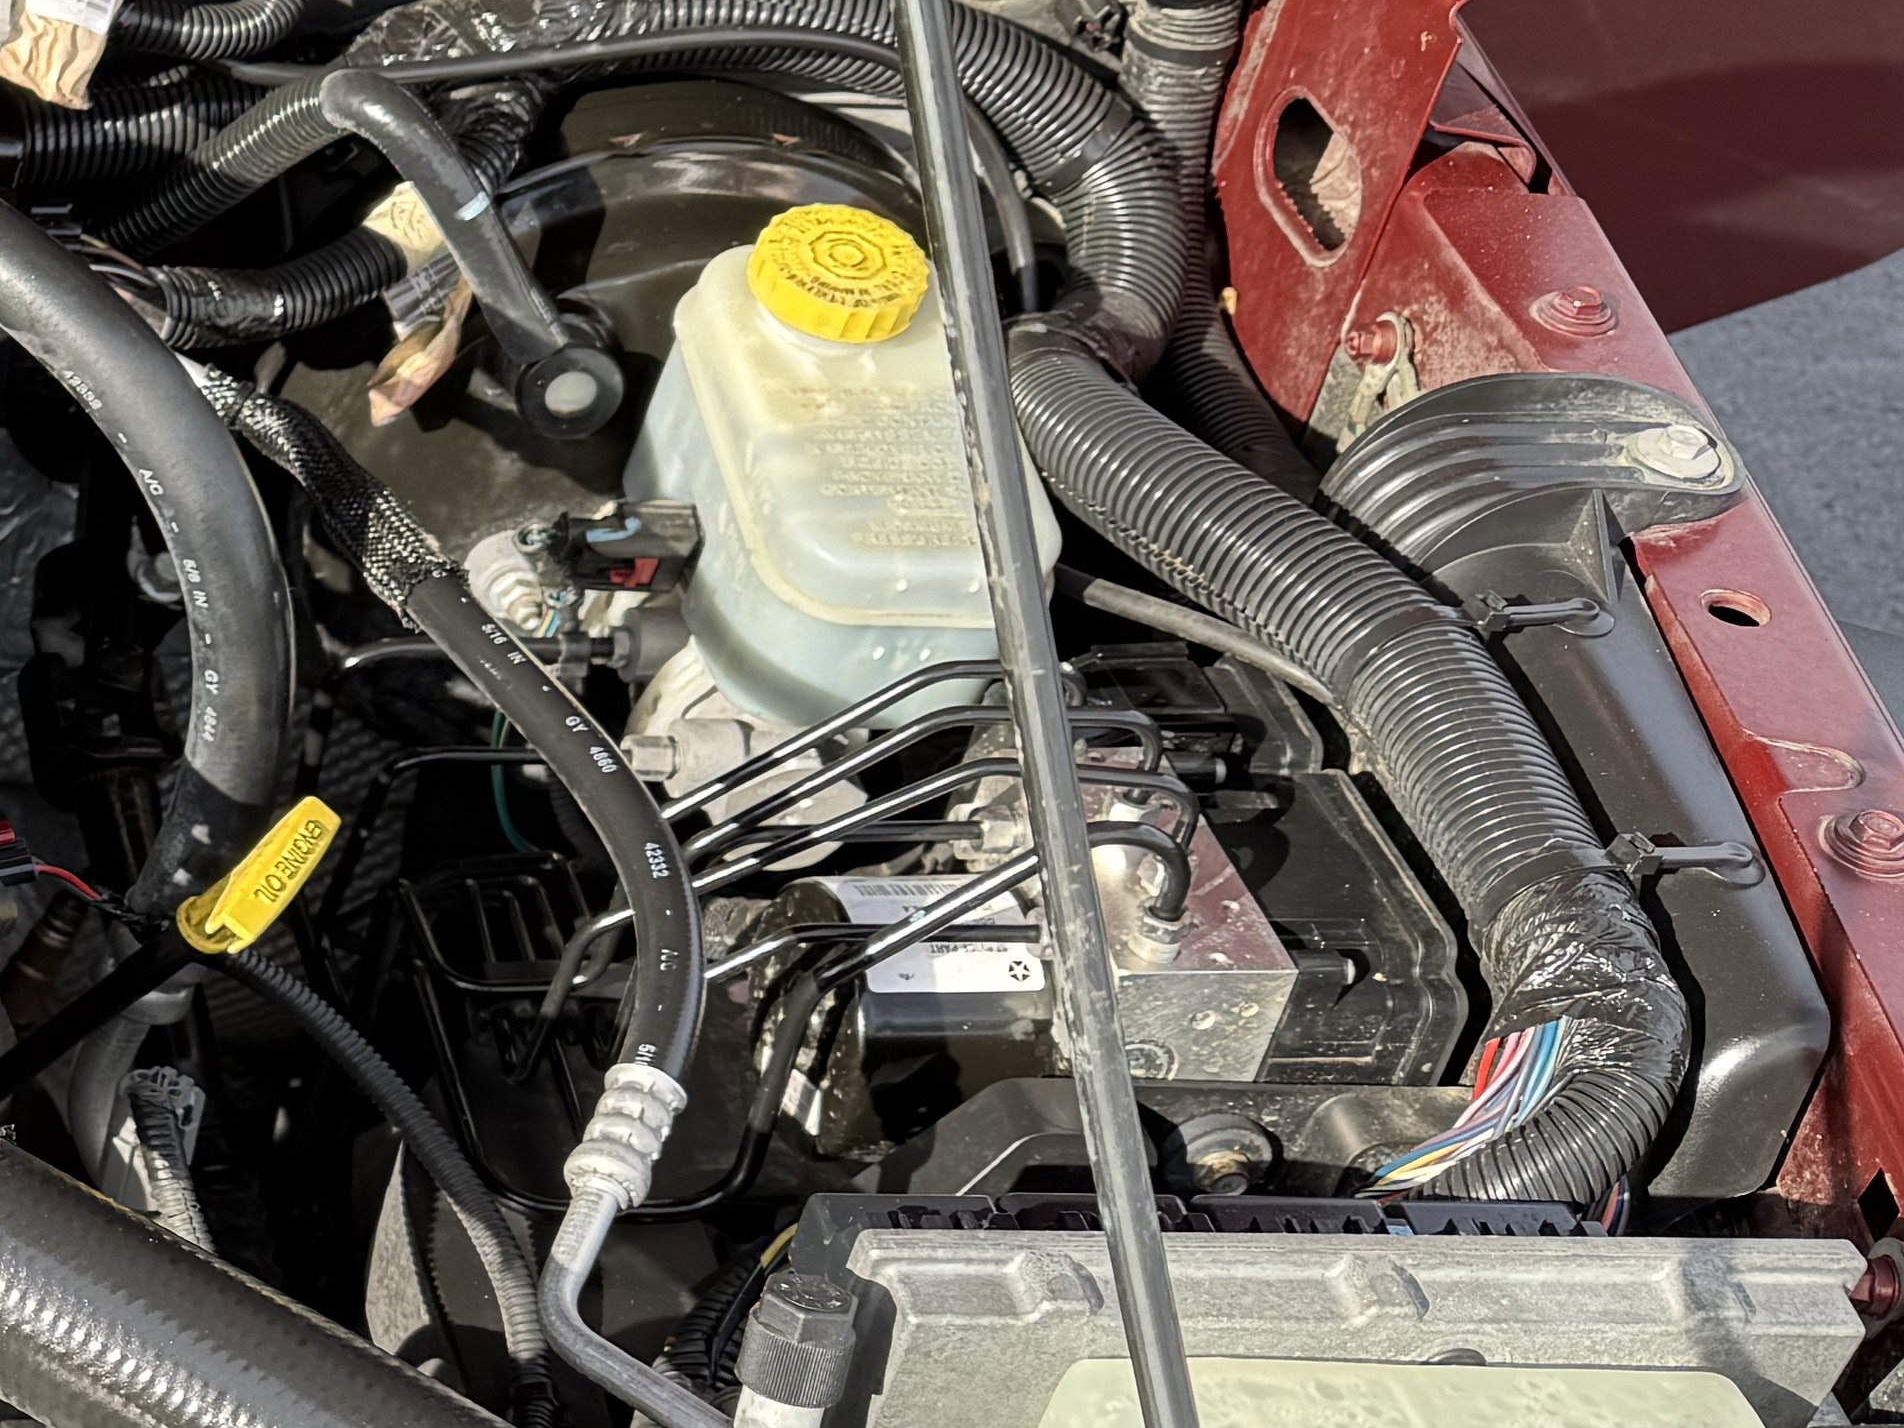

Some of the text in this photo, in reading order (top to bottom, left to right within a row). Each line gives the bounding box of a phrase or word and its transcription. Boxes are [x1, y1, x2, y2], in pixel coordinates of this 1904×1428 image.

[137, 468, 165, 498] A/C
[507, 651, 527, 665] IN
[565, 715, 589, 733] GY
[253, 819, 323, 903] ENGINE OIL
